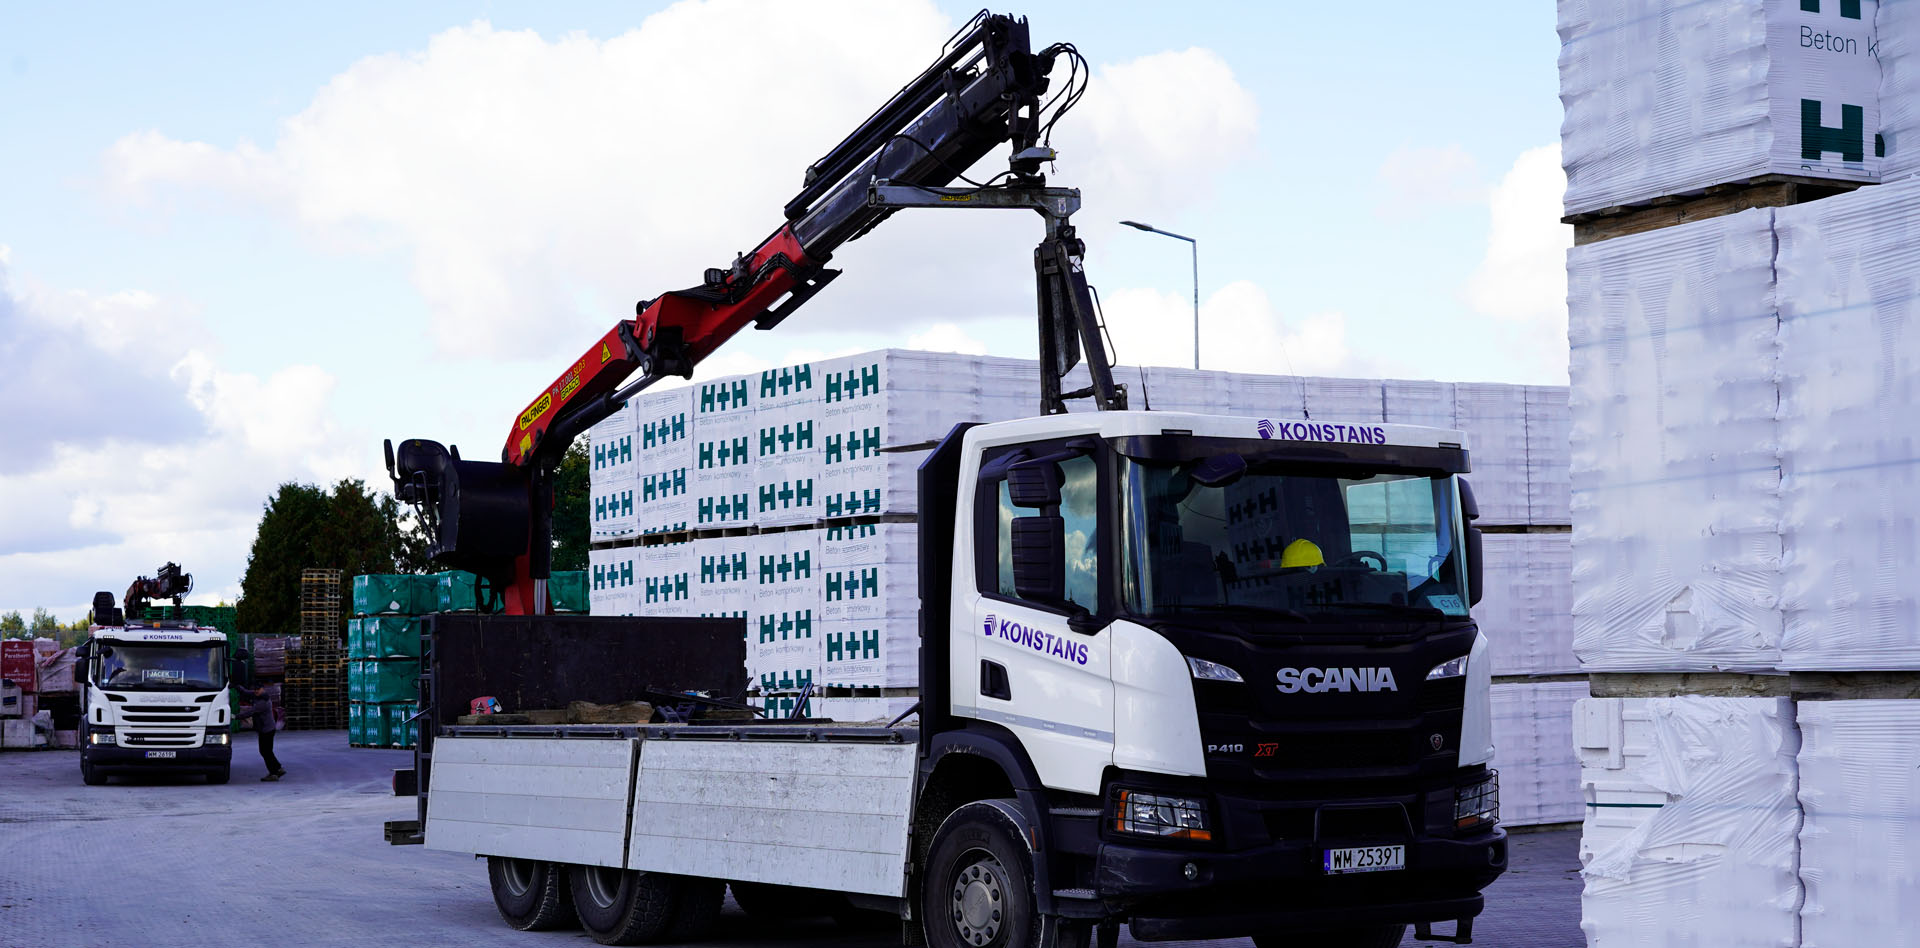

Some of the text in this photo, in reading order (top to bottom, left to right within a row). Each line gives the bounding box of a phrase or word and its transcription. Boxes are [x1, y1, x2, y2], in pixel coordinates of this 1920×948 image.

[1800, 25, 1857, 55] Beton
[701, 379, 748, 413] H+H
[760, 363, 812, 398] H+H
[826, 364, 879, 403] H+H
[521, 395, 550, 427] PALFINGER
[825, 408, 841, 418] Beton
[643, 412, 685, 450] H+H
[760, 419, 813, 456] H+H
[826, 426, 880, 464] H+H
[1279, 422, 1386, 445] KONSTANS
[595, 435, 632, 470] H+H
[699, 436, 748, 469] H+H
[643, 467, 686, 503] H+H
[759, 478, 813, 512] H+H
[595, 490, 633, 521] H+H
[698, 493, 748, 523] H+H
[594, 560, 633, 590] H+H
[701, 552, 747, 583] H+H
[759, 550, 811, 584] H+H
[646, 572, 688, 603] H+H
[826, 567, 878, 602] H+H
[760, 609, 811, 644] H+H
[1000, 619, 1089, 665] KONSTANS
[827, 629, 879, 662] H+H
[1276, 667, 1398, 693] SCANIA
[1208, 744, 1244, 753] P 410
[1255, 743, 1279, 757] XT
[1334, 849, 1352, 868] WM
[1357, 847, 1401, 867] 2539T
